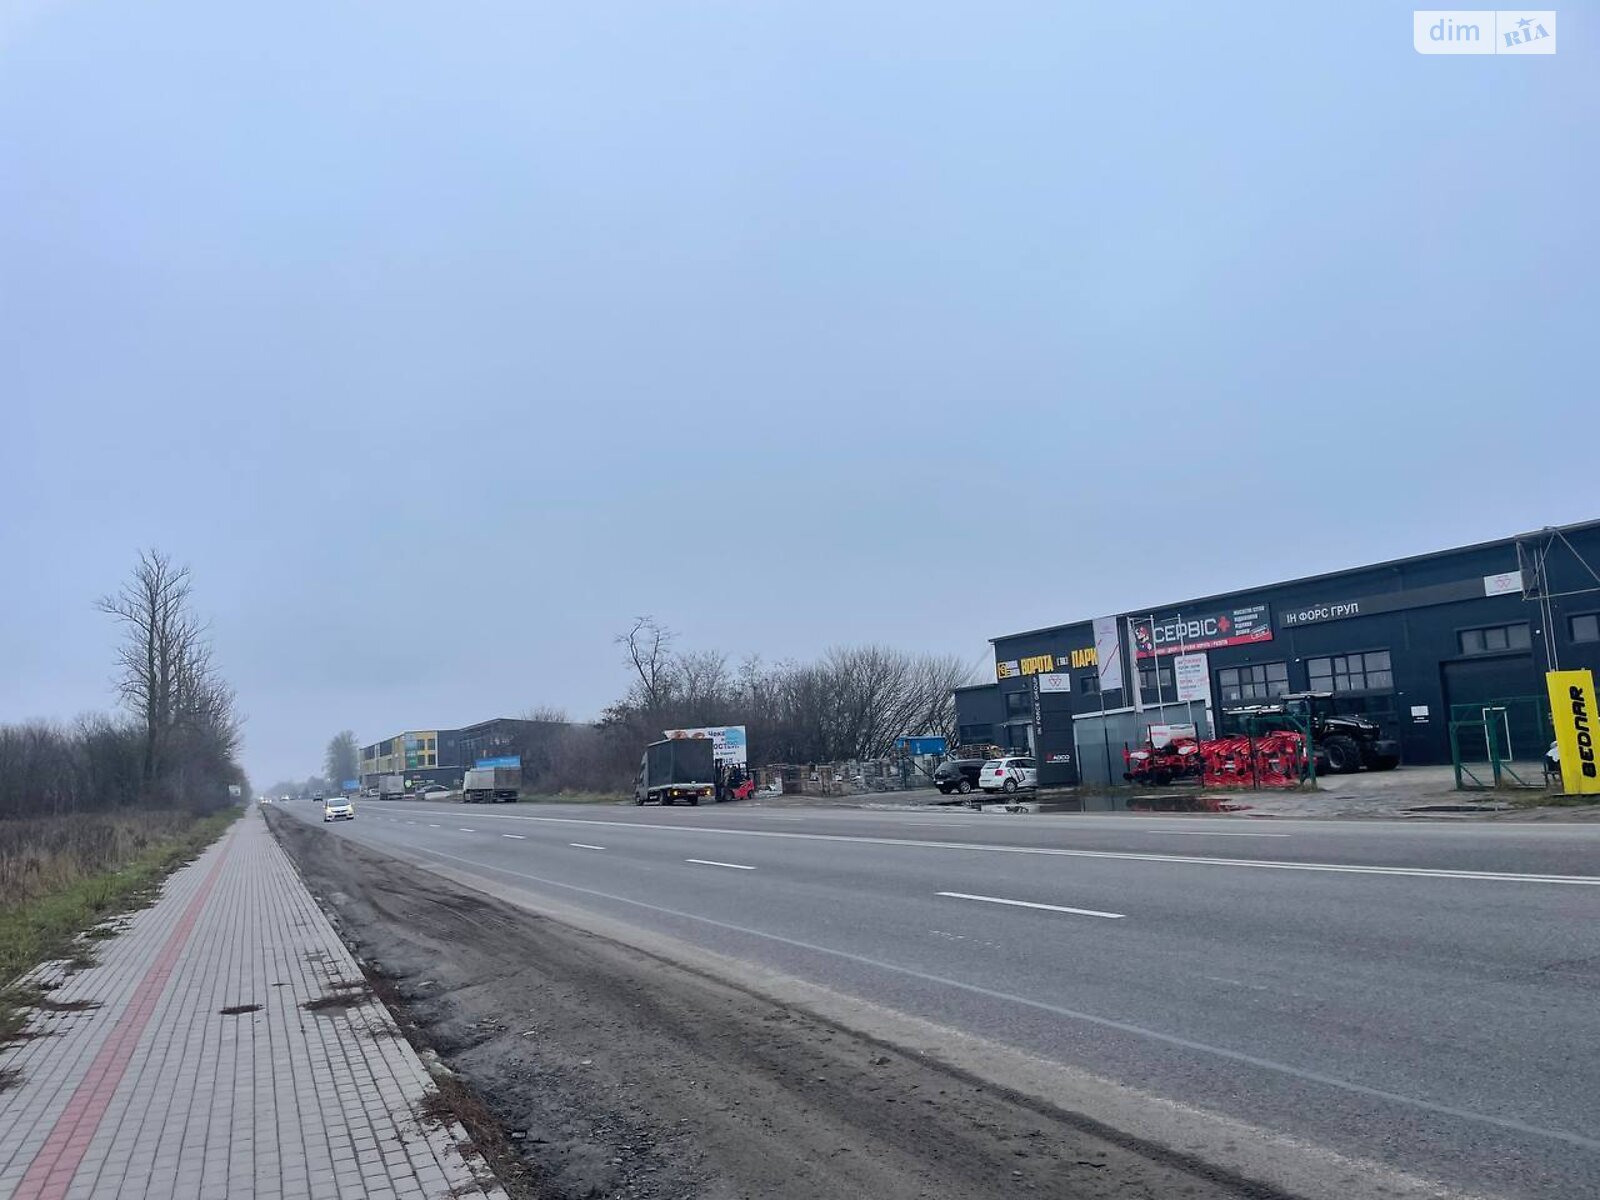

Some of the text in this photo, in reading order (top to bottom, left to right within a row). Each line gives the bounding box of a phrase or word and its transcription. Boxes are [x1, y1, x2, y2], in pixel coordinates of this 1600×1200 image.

[1299, 608, 1329, 621] ФОРС
[1330, 603, 1359, 617] ГРУП
[1020, 654, 1054, 676] ВОРОТА
[1569, 685, 1597, 778] BEDNAR
